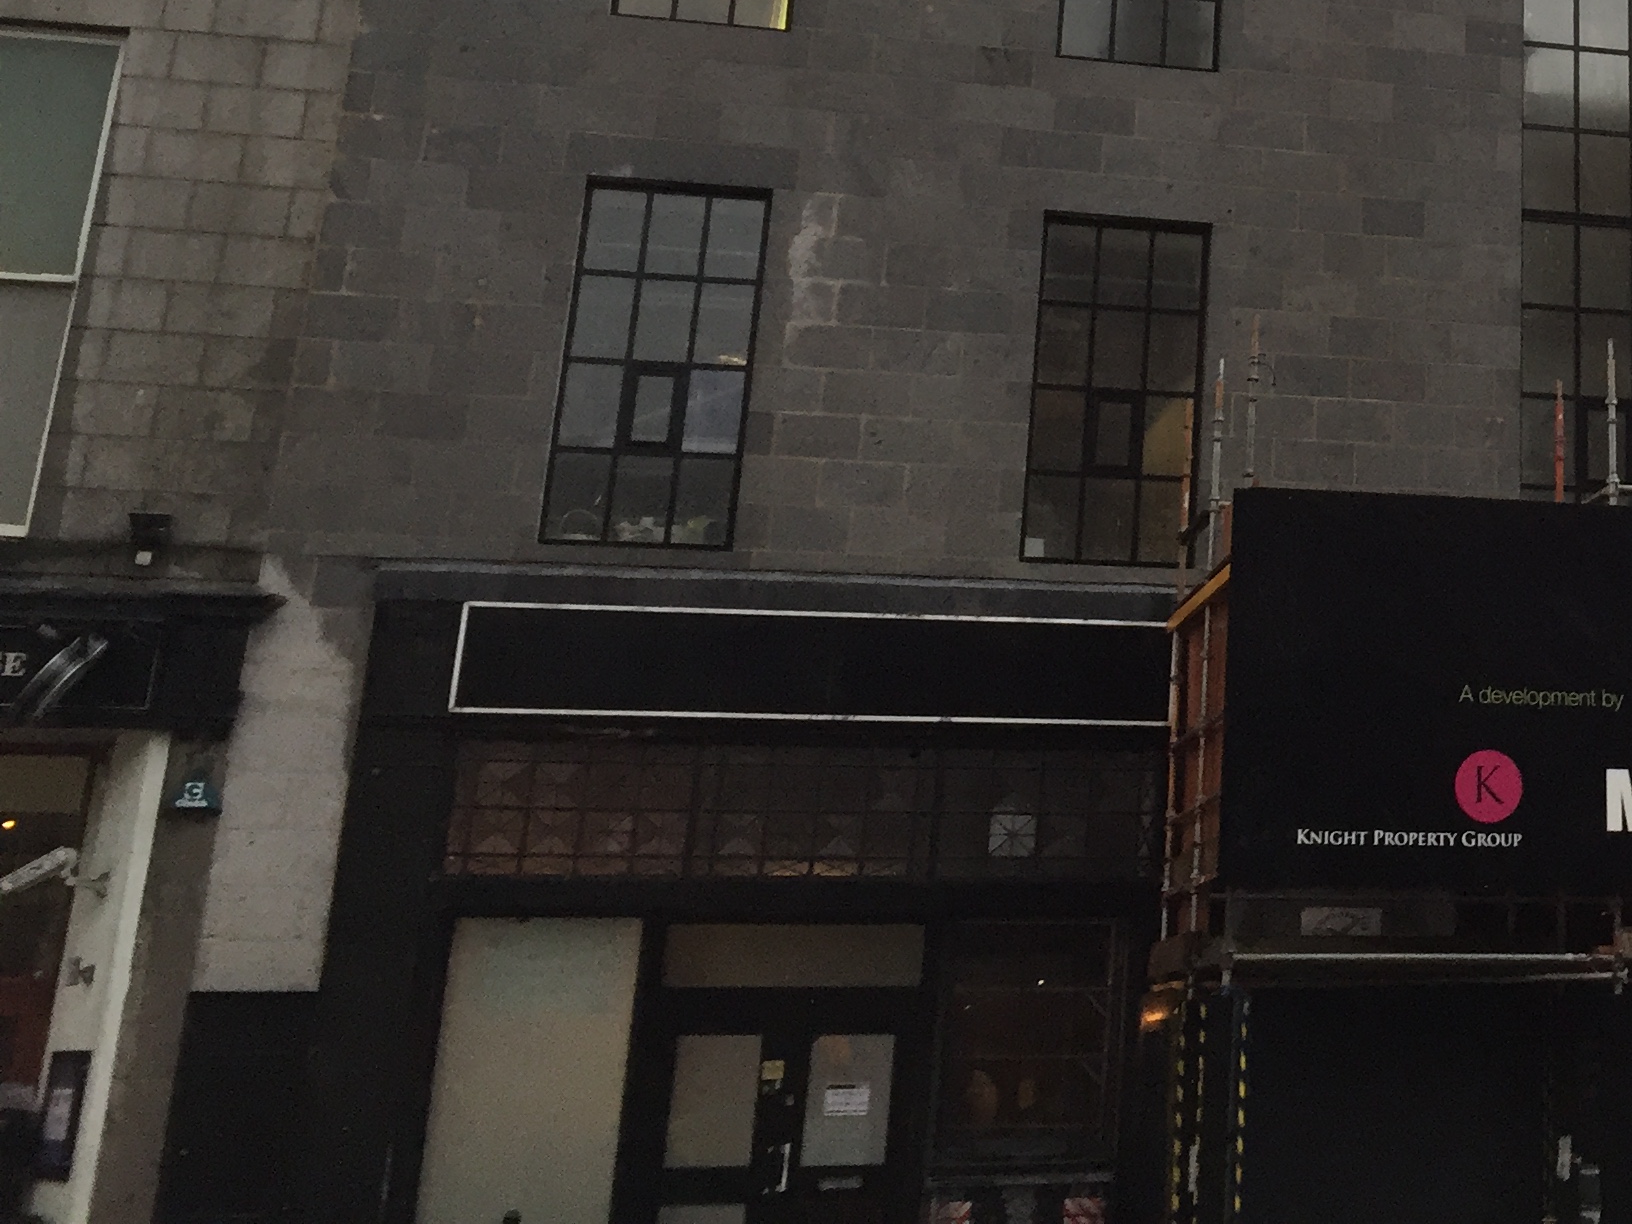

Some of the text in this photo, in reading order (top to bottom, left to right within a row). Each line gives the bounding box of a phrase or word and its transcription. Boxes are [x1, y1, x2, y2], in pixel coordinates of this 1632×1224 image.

[1458, 684, 1625, 712] A development by
[1474, 764, 1505, 806] K
[1295, 828, 1524, 849] KNIGHT PROPERTY GROUP
